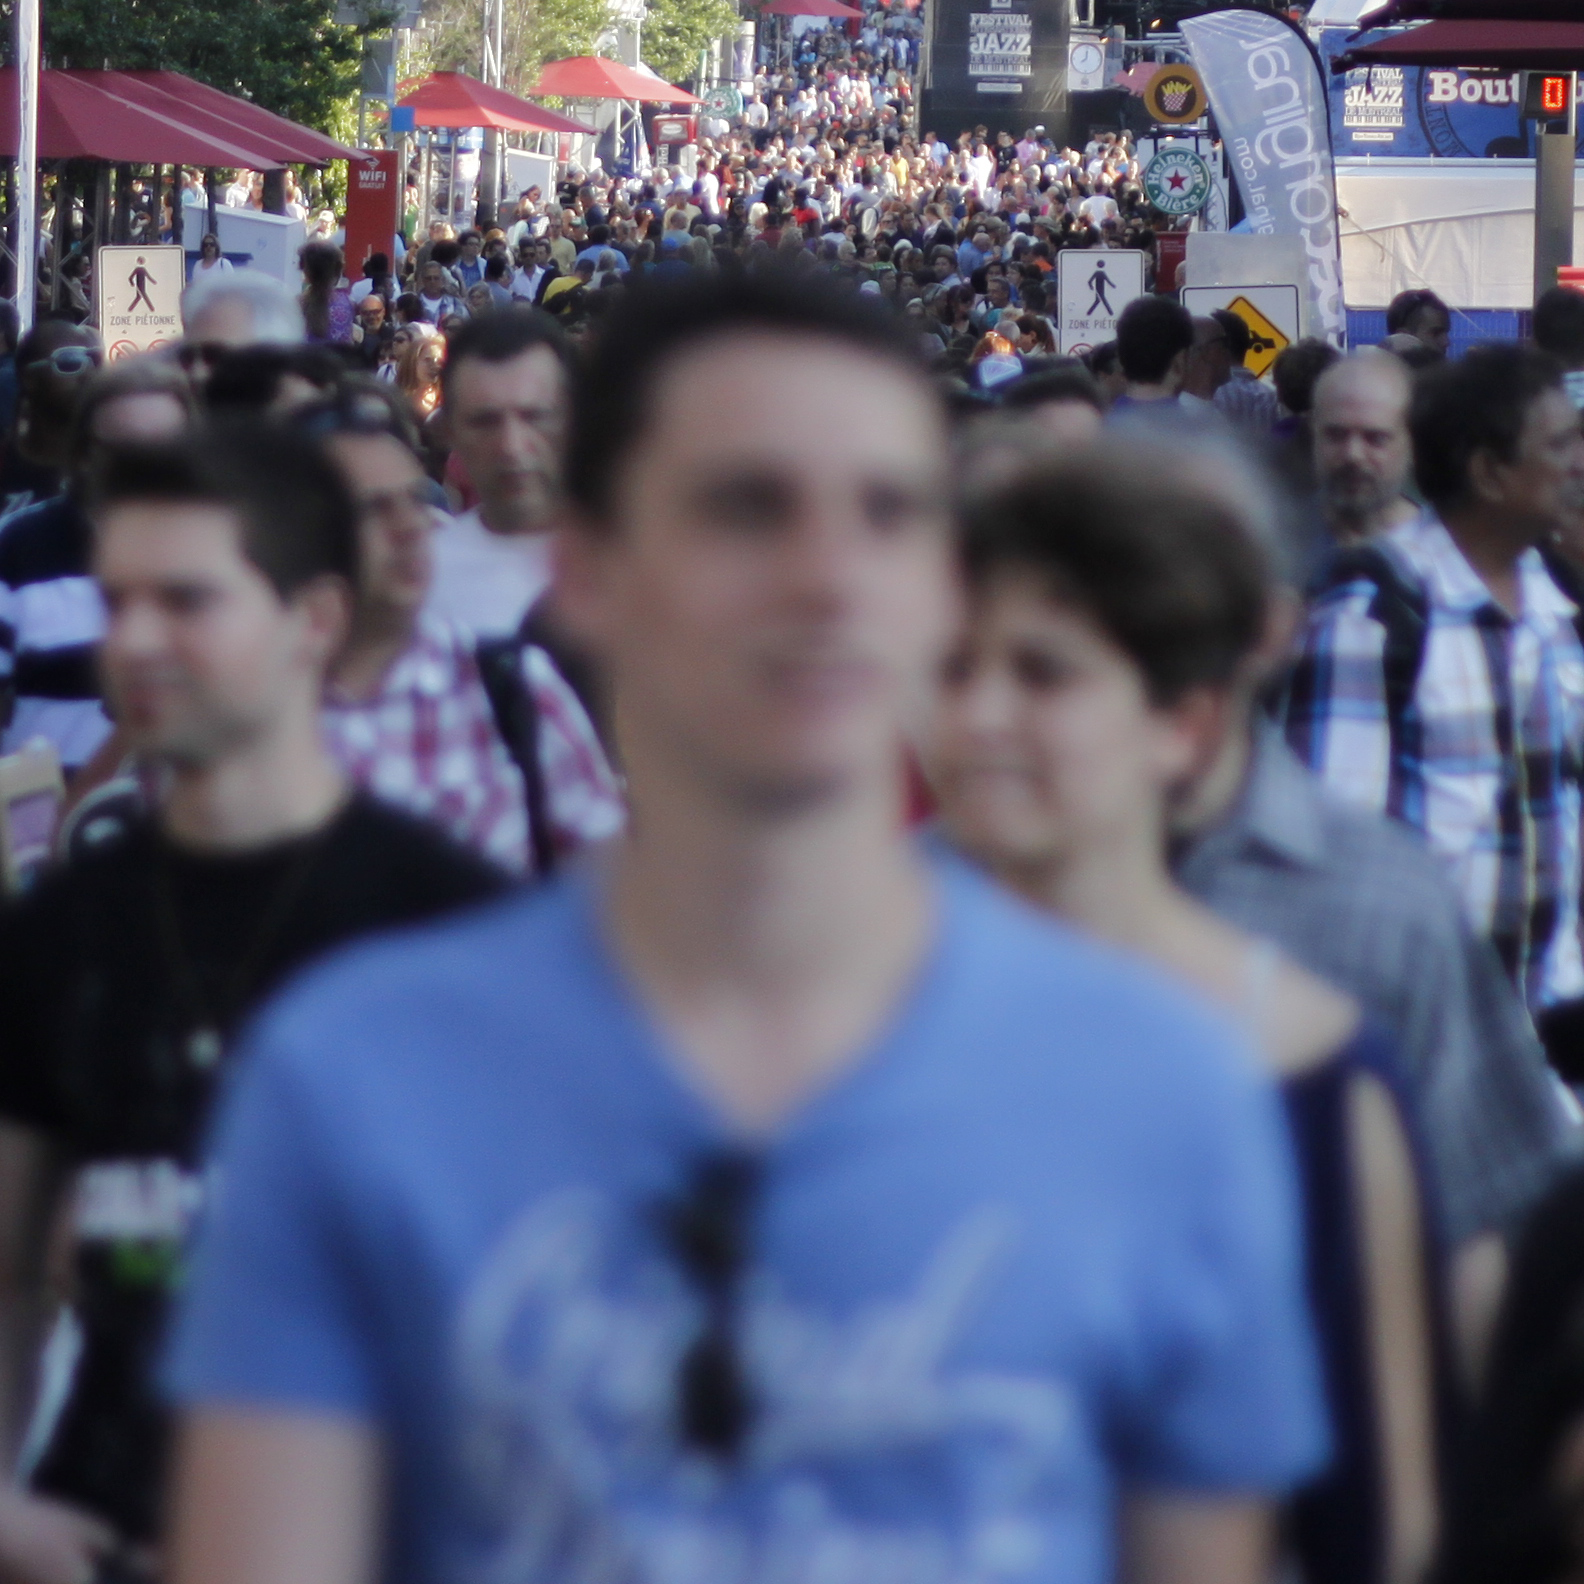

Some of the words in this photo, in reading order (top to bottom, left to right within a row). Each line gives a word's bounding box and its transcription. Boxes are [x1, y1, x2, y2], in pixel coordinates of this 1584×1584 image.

[970, 13, 1032, 26] FESTIVAL
[970, 33, 1032, 55] JAZZ
[1345, 85, 1403, 106] JAZZ
[1148, 153, 1204, 185] Heineken
[1155, 193, 1200, 211] Bière
[110, 316, 132, 325] ZONE
[135, 314, 175, 325] PIÉTONNE
[1069, 319, 1090, 329] ZONE
[1094, 317, 1117, 329] PIÉTO
